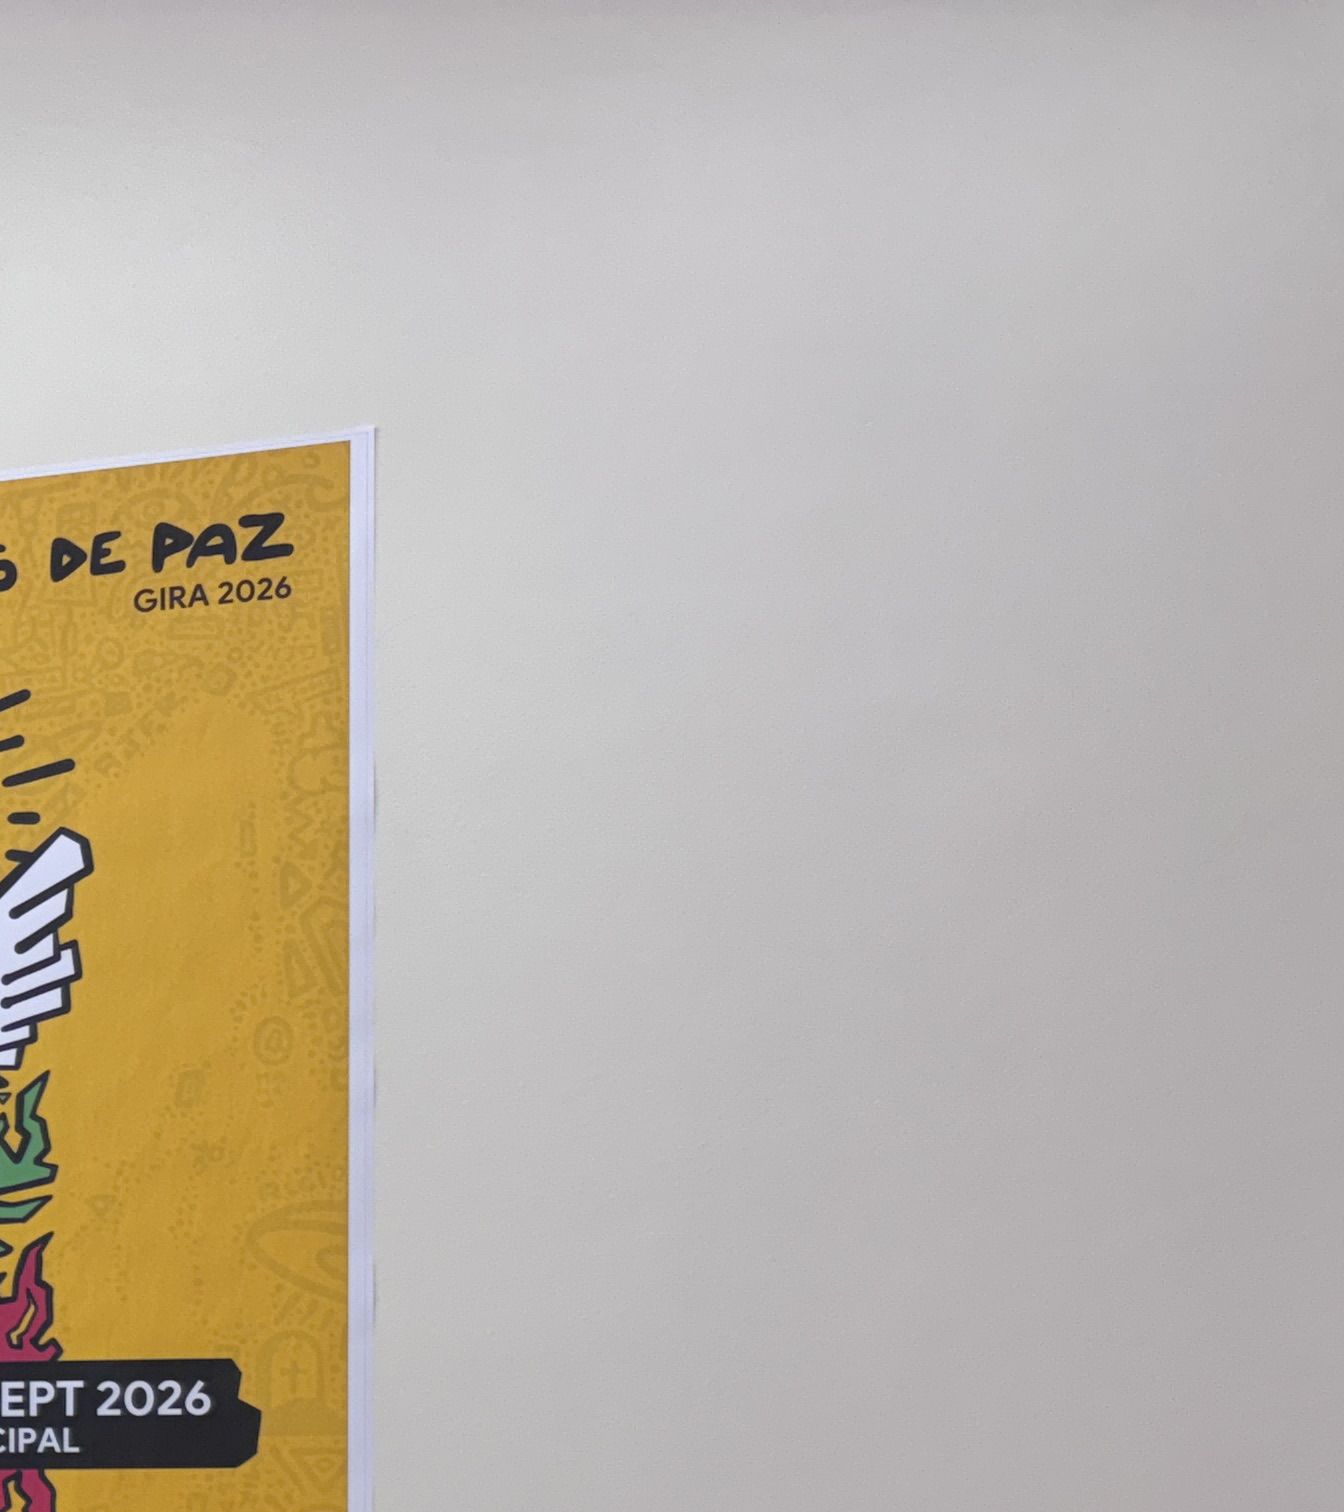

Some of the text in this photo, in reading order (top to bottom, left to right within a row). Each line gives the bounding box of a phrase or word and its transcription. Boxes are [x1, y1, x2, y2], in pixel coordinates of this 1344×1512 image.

[50, 528, 127, 583] DE
[151, 511, 294, 572] PAZ
[133, 575, 292, 614] GIRA 2026
[96, 1377, 213, 1417] 2026
